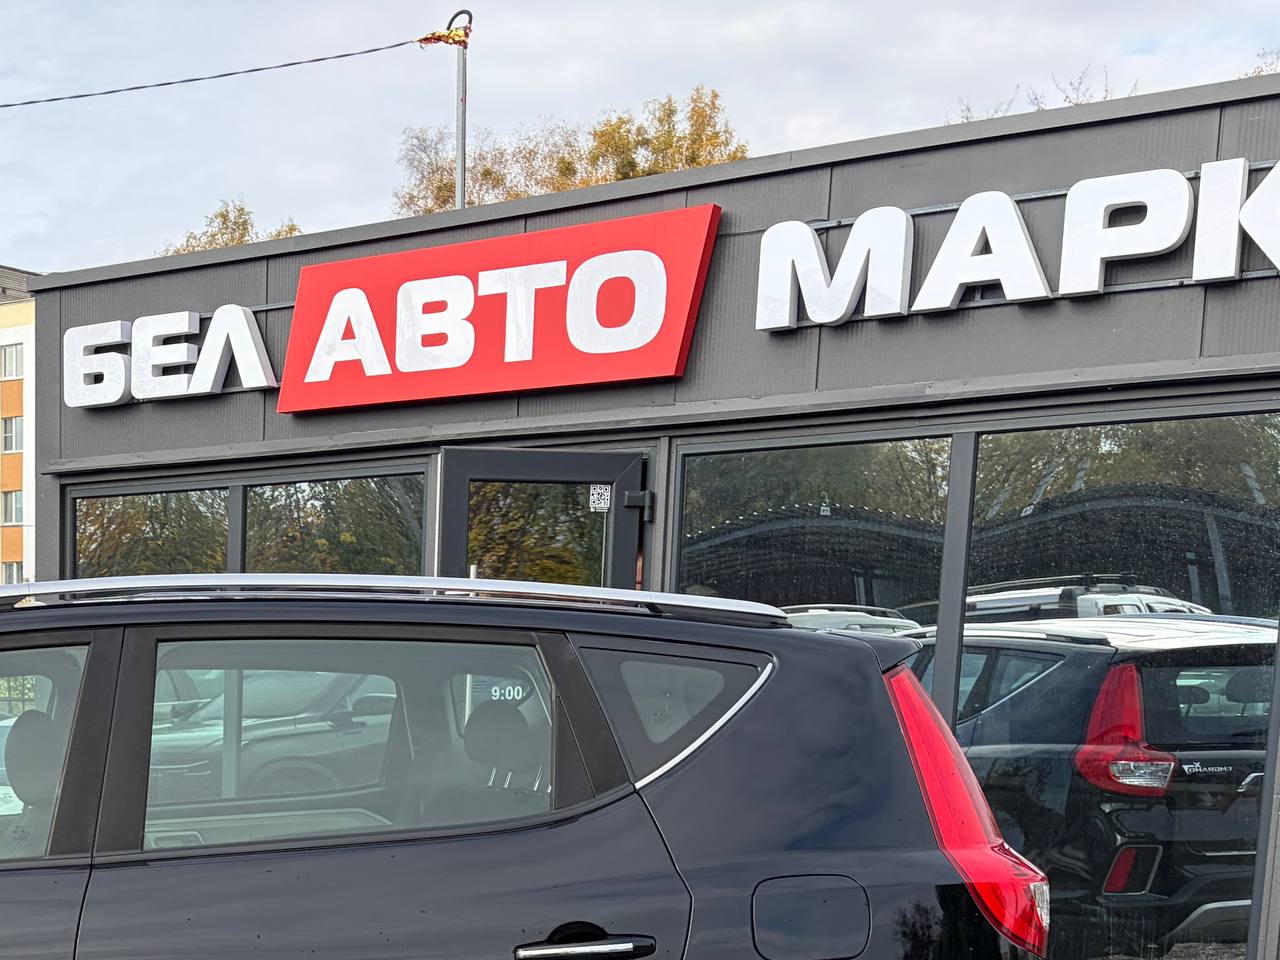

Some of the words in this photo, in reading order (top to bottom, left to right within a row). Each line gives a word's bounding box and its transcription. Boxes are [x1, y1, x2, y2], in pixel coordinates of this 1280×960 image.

[63, 303, 277, 407] БЕЛ
[303, 249, 668, 384] АВТО
[491, 686, 523, 701] 9:00
